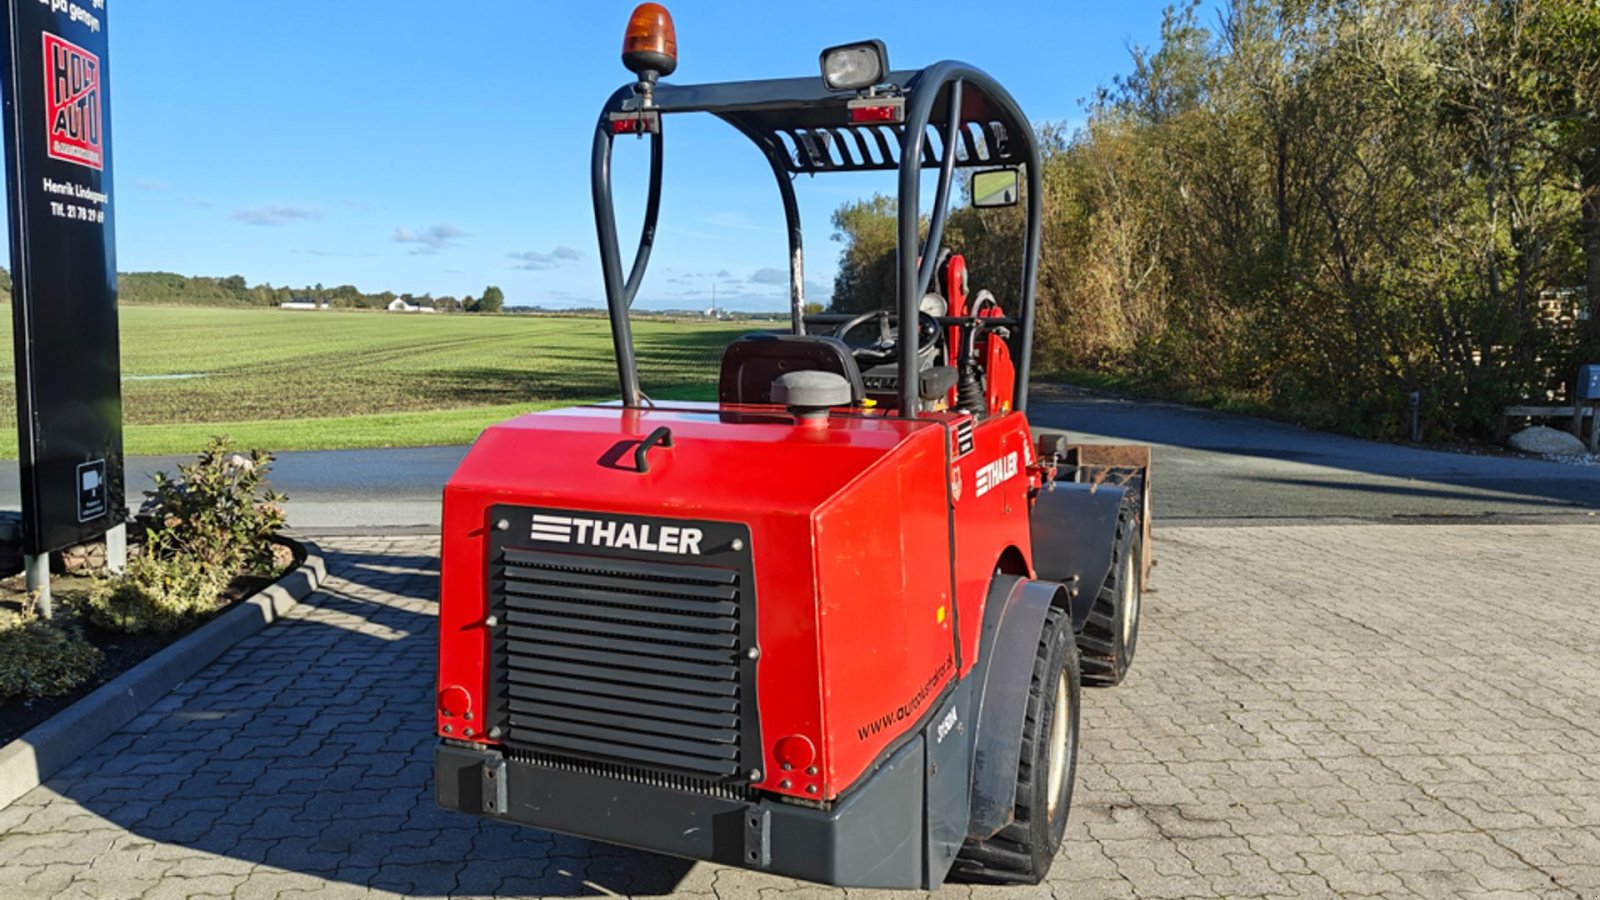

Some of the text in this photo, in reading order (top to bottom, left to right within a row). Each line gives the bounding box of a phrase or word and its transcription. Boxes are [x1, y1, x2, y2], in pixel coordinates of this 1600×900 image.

[52, 43, 96, 107] HOLT
[54, 88, 98, 146] AUTO
[43, 177, 75, 196] Henrik
[986, 451, 1018, 490] THALER
[572, 517, 703, 555] THALER
